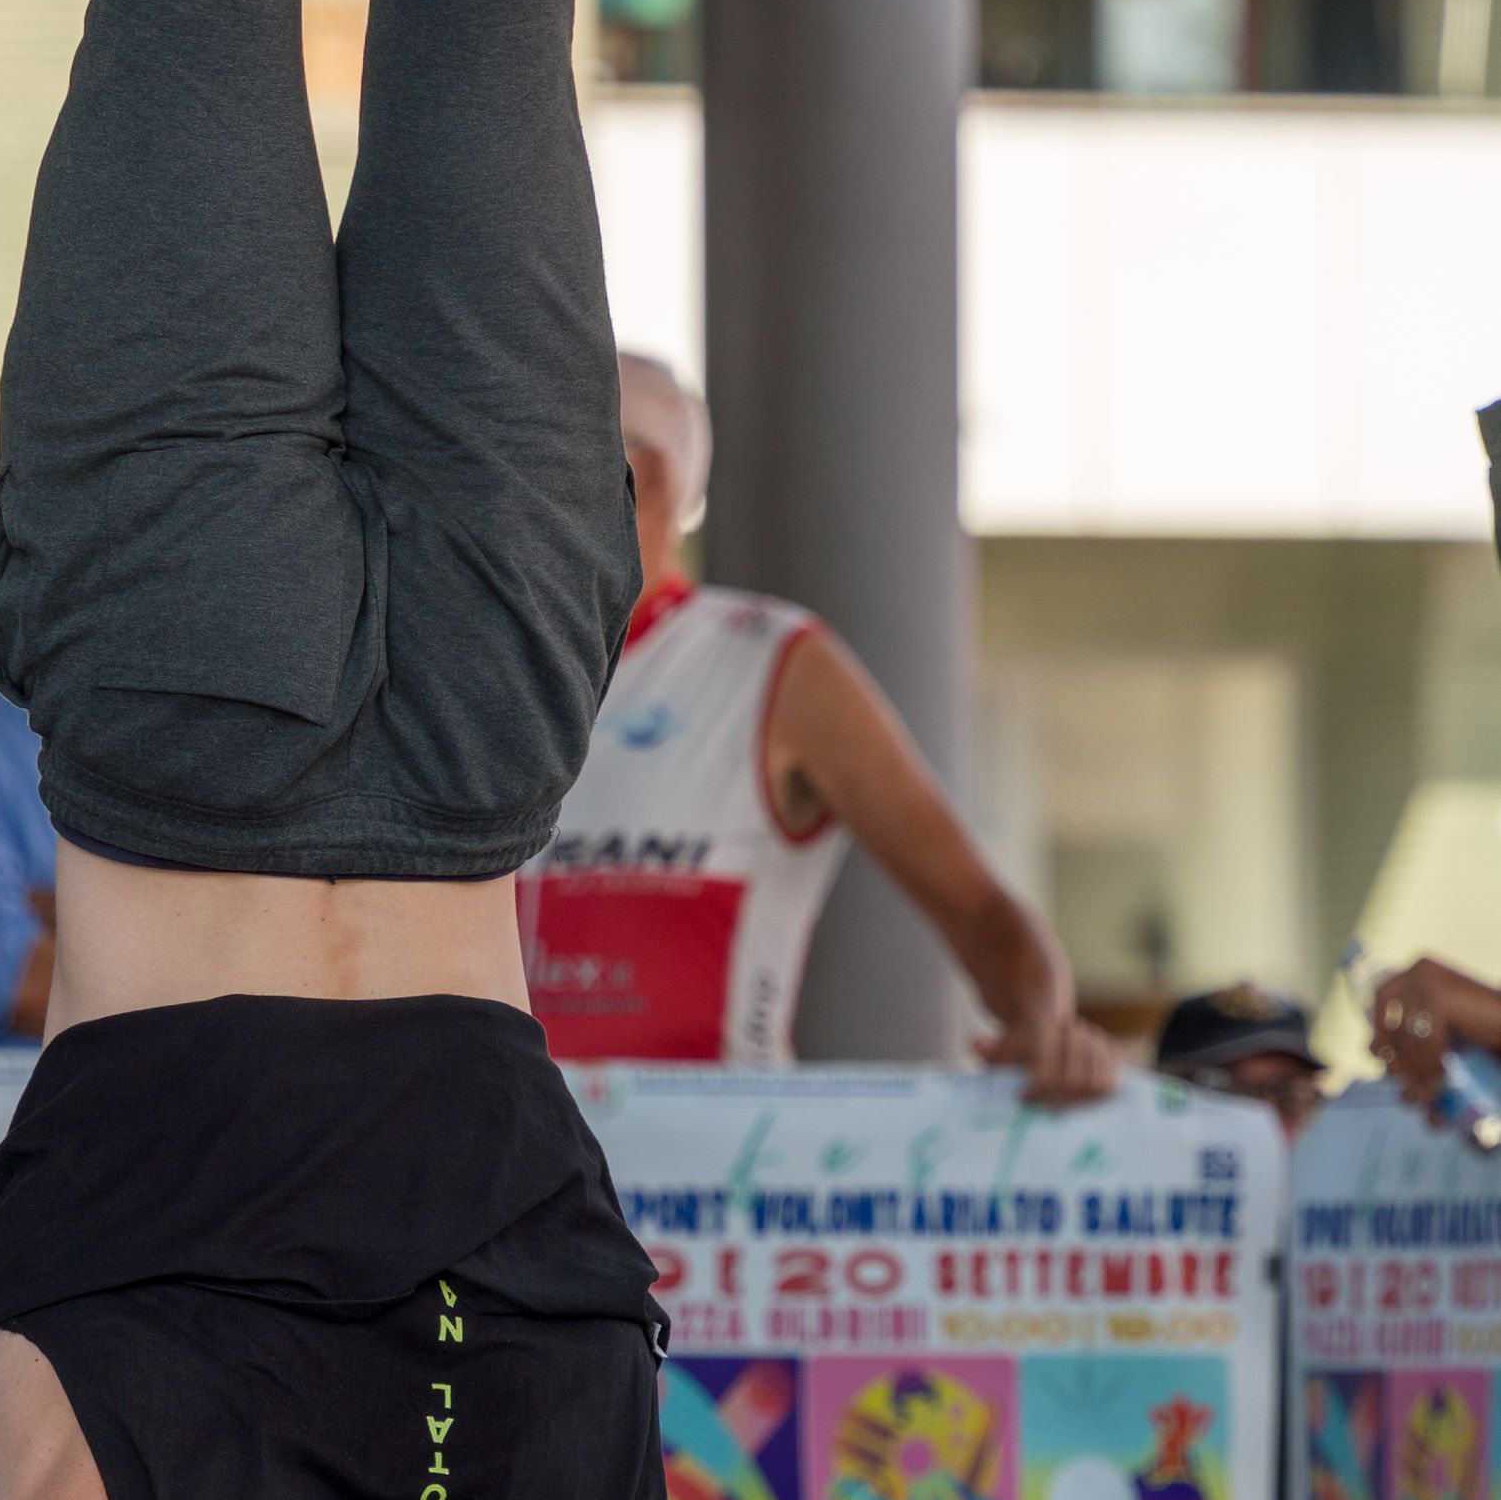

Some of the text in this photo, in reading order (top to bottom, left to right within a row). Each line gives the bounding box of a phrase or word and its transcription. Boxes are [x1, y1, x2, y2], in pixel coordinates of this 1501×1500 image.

[750, 1186, 1064, 1238] VOLONTARIATO
[1080, 1188, 1240, 1238] SALUTE
[772, 1245, 905, 1297] 20
[934, 1247, 1237, 1298] SETTEMBRE
